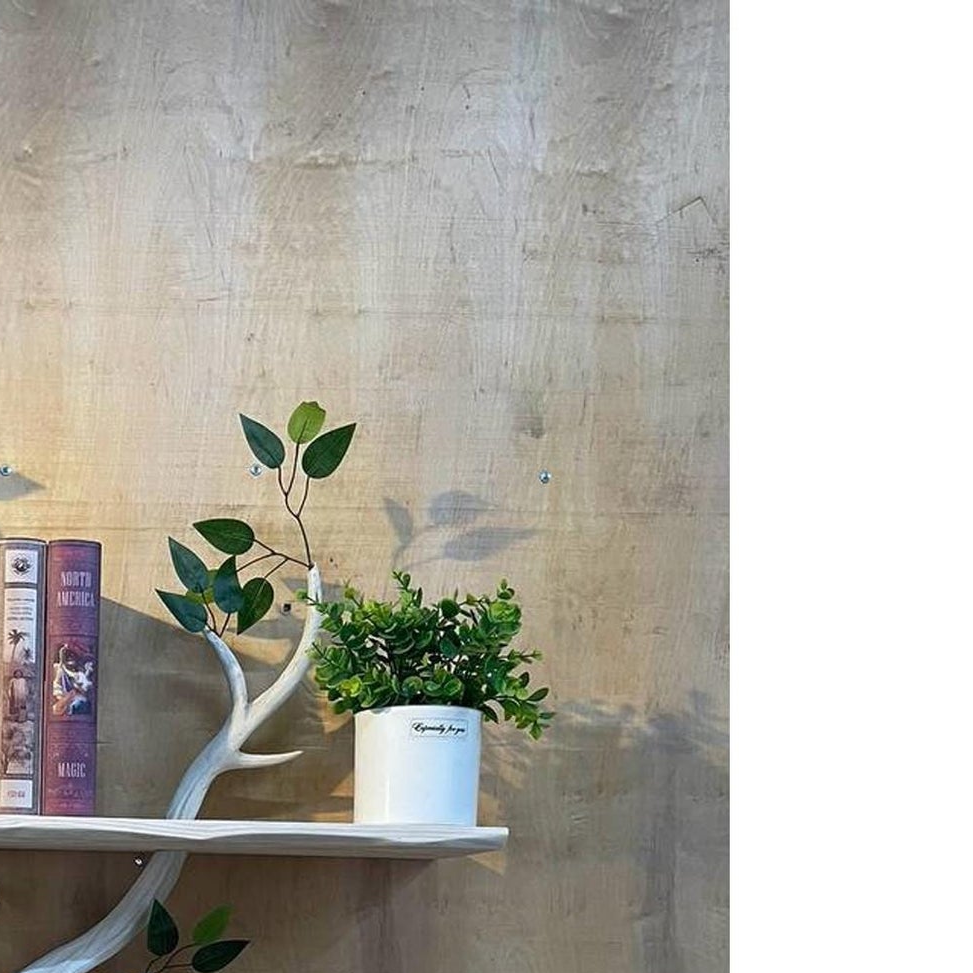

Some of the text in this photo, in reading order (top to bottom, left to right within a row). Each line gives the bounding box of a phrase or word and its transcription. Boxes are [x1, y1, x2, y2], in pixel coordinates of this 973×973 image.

[60, 571, 92, 587] NORTH
[56, 591, 95, 607] AMERICA
[55, 763, 86, 778] MAGIC
